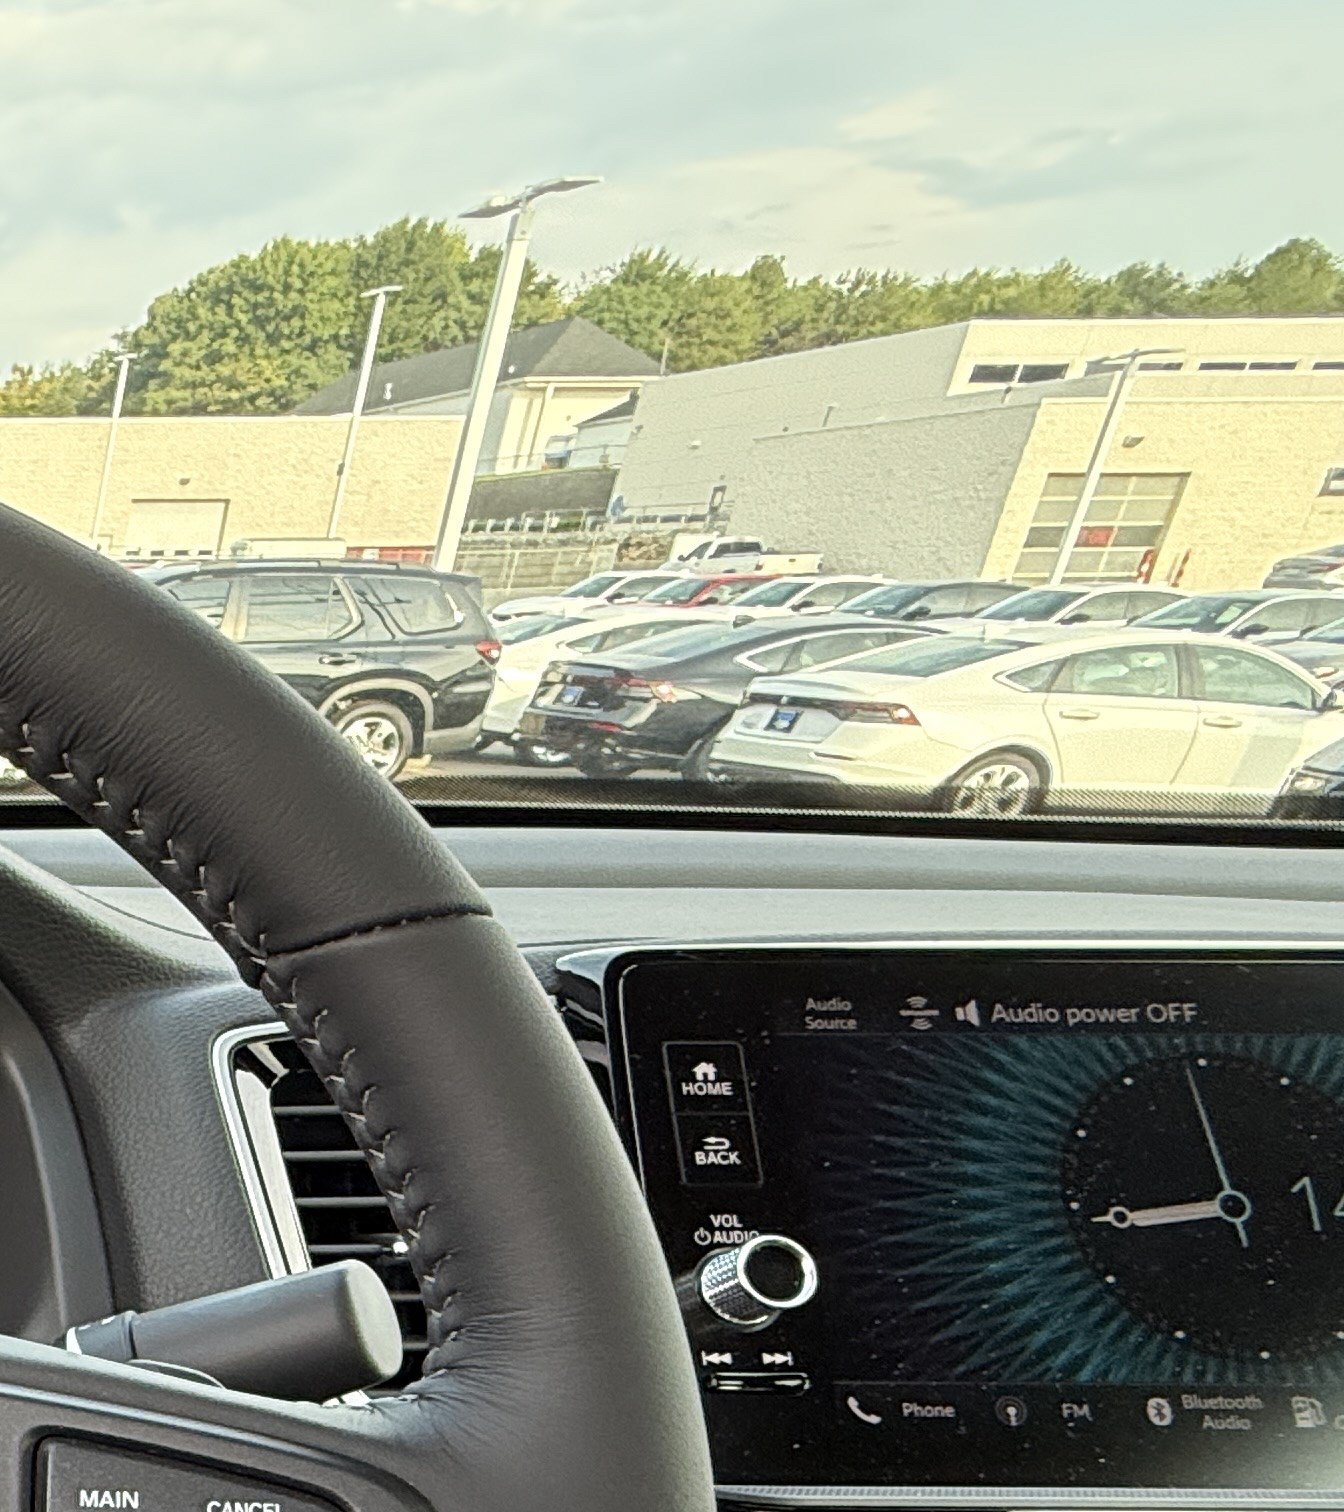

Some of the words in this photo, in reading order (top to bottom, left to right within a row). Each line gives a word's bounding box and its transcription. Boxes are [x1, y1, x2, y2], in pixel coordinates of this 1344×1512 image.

[805, 998, 852, 1013] Audio
[990, 1002, 1059, 1024] Audio
[1066, 1005, 1140, 1027] power
[1146, 1002, 1199, 1023] OFF
[804, 1016, 858, 1031] Source
[681, 1082, 734, 1096] HOME
[694, 1151, 742, 1166] BACK
[709, 1214, 743, 1228] VOL
[1181, 1394, 1264, 1410] Bluetooth
[902, 1402, 956, 1418] Phone
[1062, 1403, 1093, 1422] FM
[1202, 1415, 1252, 1430] Audio
[79, 1490, 140, 1509] MAIN
